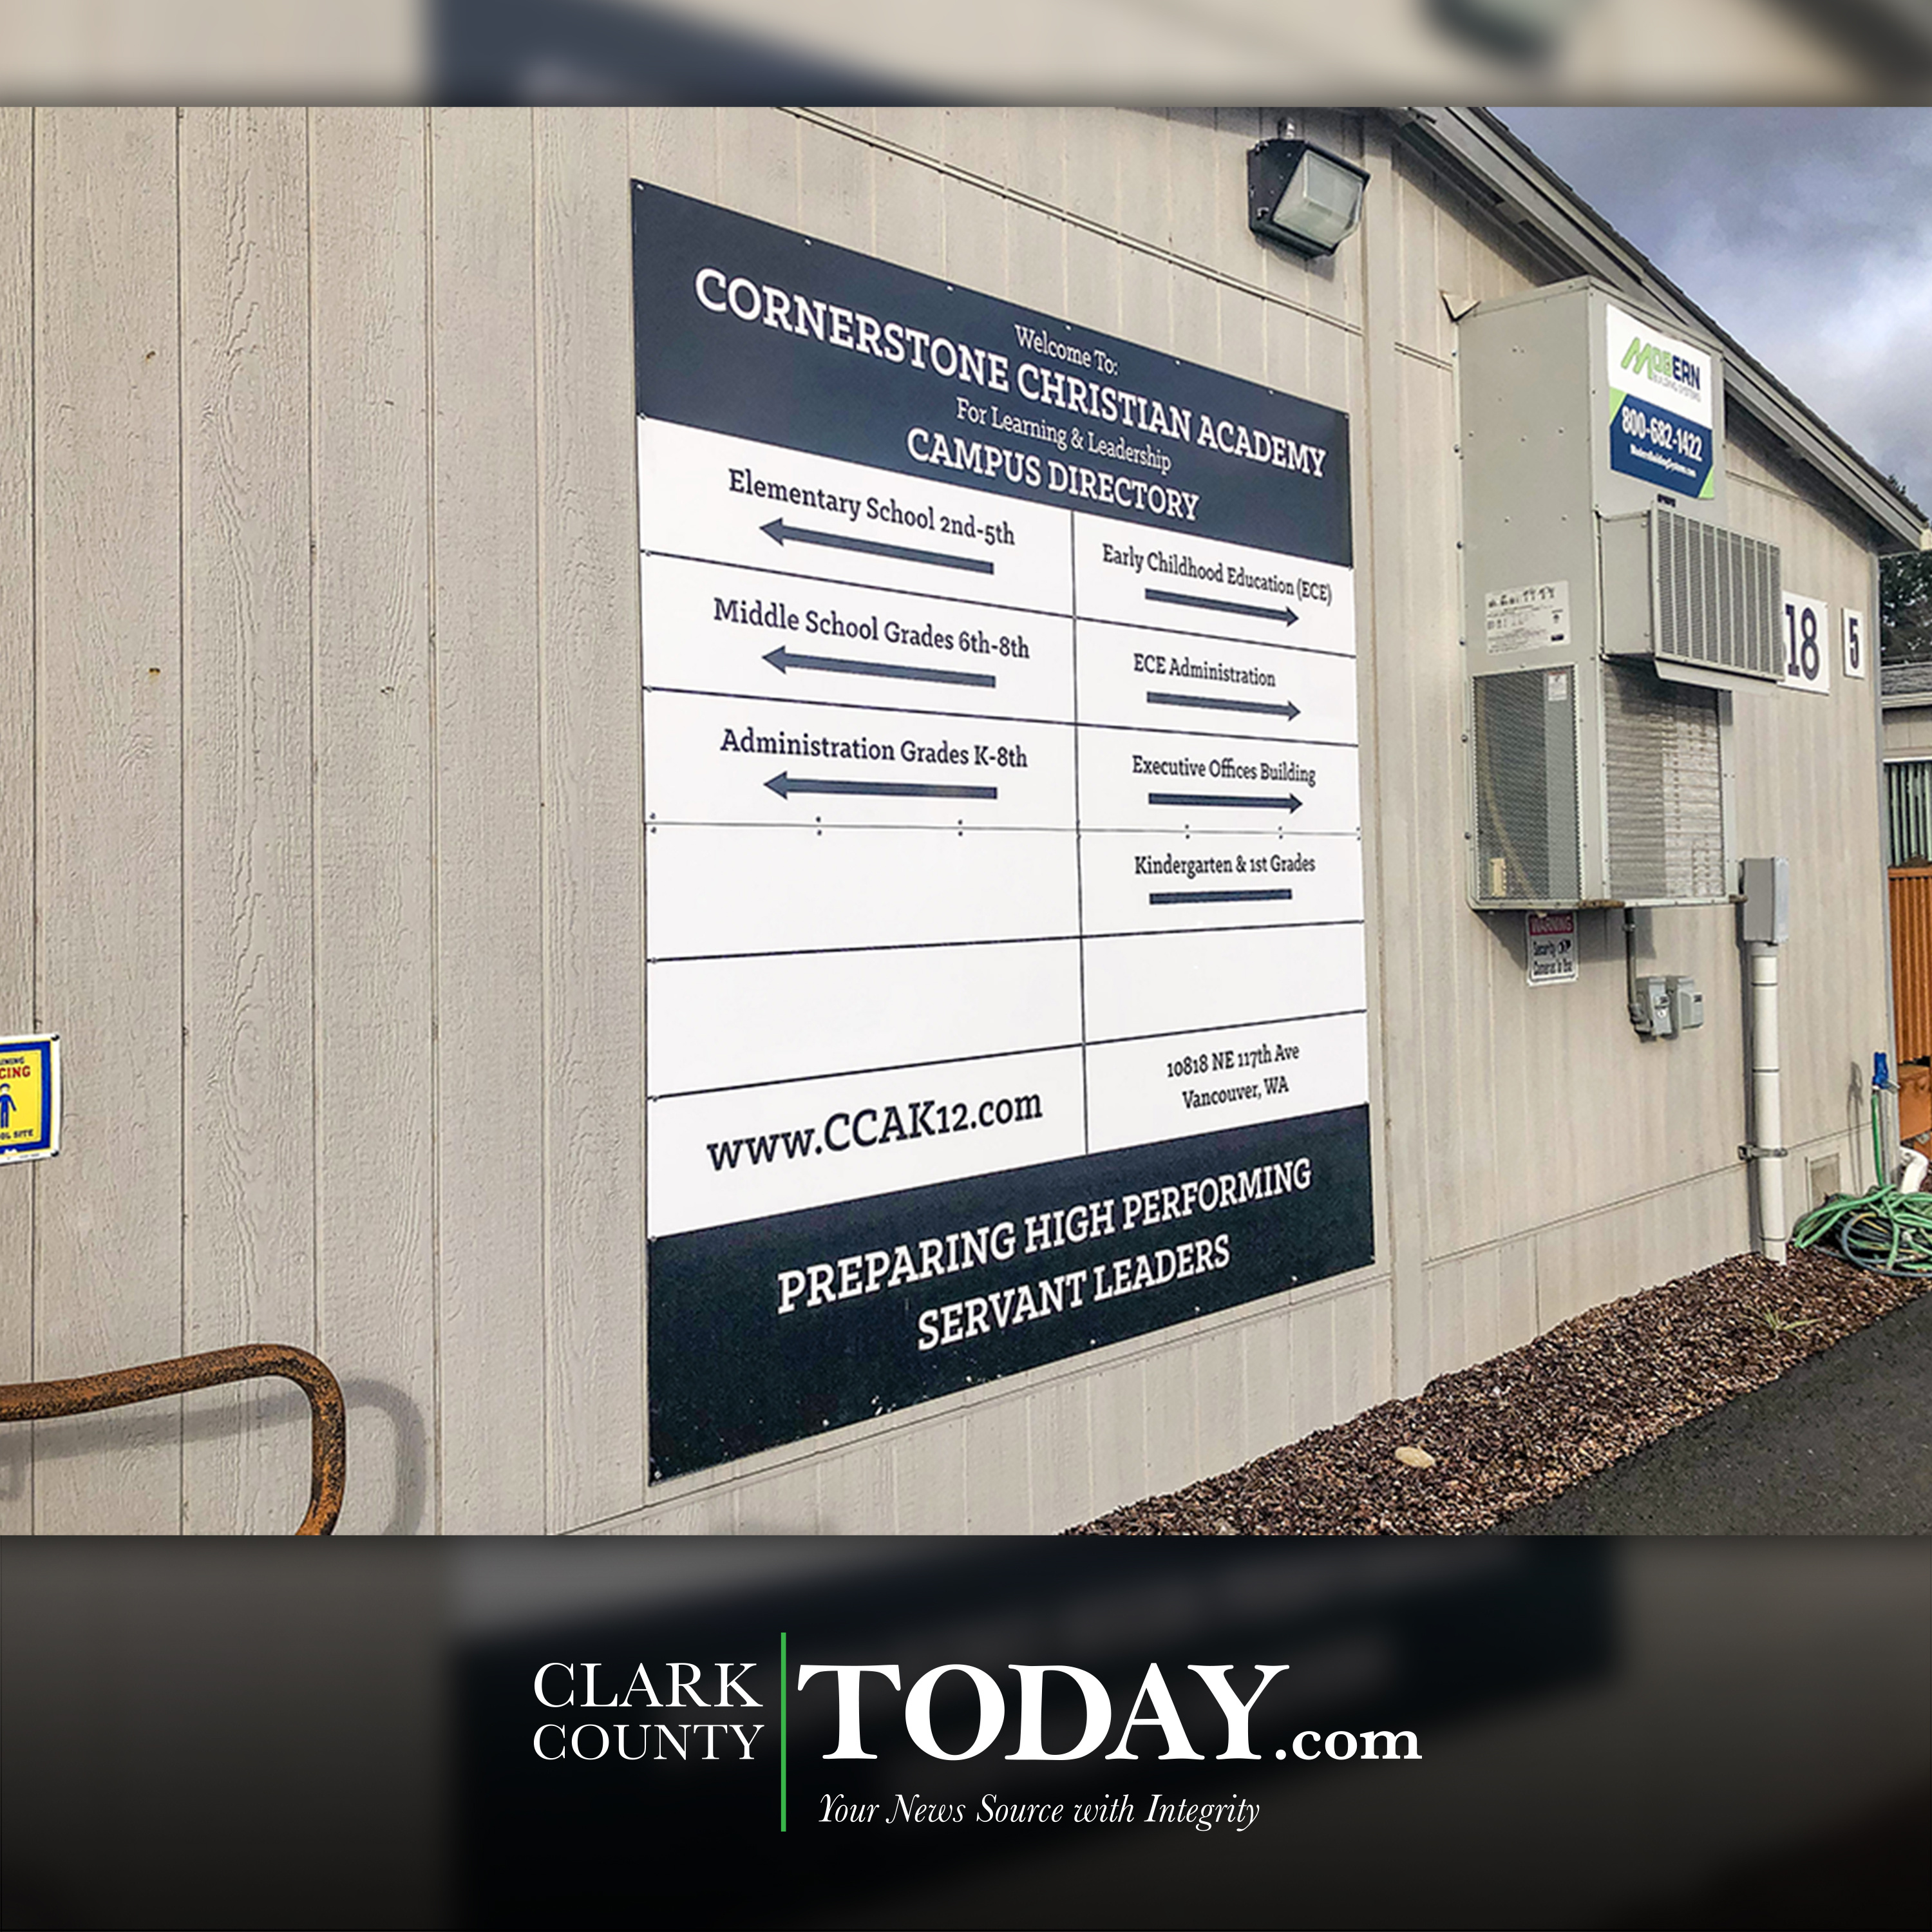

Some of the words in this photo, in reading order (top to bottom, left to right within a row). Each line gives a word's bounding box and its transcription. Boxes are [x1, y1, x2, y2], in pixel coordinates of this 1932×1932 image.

[696, 269, 1009, 392] CORNERSTONE
[1018, 363, 1191, 442] CHRISTIAN
[1197, 415, 1326, 477] ACADEMY
[1014, 324, 1092, 368] Welcome
[1094, 350, 1118, 375] To:
[956, 397, 987, 425] For
[991, 406, 1068, 451] Learning
[1070, 427, 1084, 450] &
[1088, 431, 1171, 475] Leadership
[1622, 405, 1703, 462] 800-682-1422
[907, 428, 1041, 487] CAMPUS
[1048, 460, 1200, 521] DIRECTORY
[728, 468, 862, 522] Elementary
[866, 497, 935, 531] School
[940, 514, 1015, 546] 2nd-5th
[1103, 543, 1144, 574] Early
[1147, 551, 1224, 583] Childhood
[1227, 567, 1294, 596] Education
[1296, 578, 1332, 606] (ECE)
[714, 597, 799, 631] Middle
[806, 610, 879, 641] School
[884, 621, 954, 650] Grades
[959, 630, 1030, 659] 6th-8th
[1783, 603, 1819, 681] 18
[1848, 616, 1859, 669] 5
[1133, 653, 1166, 675] ECE
[1169, 656, 1276, 687] Administration
[719, 726, 895, 761] Administration
[900, 740, 969, 765] Grades
[974, 744, 1028, 768] K-8th
[1132, 755, 1206, 777] Executive
[1209, 757, 1258, 780] Offices
[1260, 761, 1316, 788] Building
[1134, 853, 1233, 880] Kindergarten
[1236, 855, 1247, 873] &
[1249, 857, 1268, 873] 1st
[1270, 852, 1316, 873] Grades
[1167, 1054, 1209, 1077] 10818
[1211, 1050, 1235, 1071] NE
[1238, 1043, 1273, 1068] 117th
[1274, 1044, 1300, 1062] Ave
[1182, 1084, 1262, 1109] Vancouver,
[1263, 1075, 1289, 1095] WA
[14, 1128, 34, 1138] SITE
[706, 1094, 1043, 1171] www.CCAK12.com
[778, 1222, 1016, 1314] PREPARING
[1024, 1199, 1115, 1253] HIGH
[1122, 1158, 1311, 1230] PERFORMING
[918, 1270, 1087, 1350] SERVANT
[1093, 1234, 1229, 1302] LEADERS
